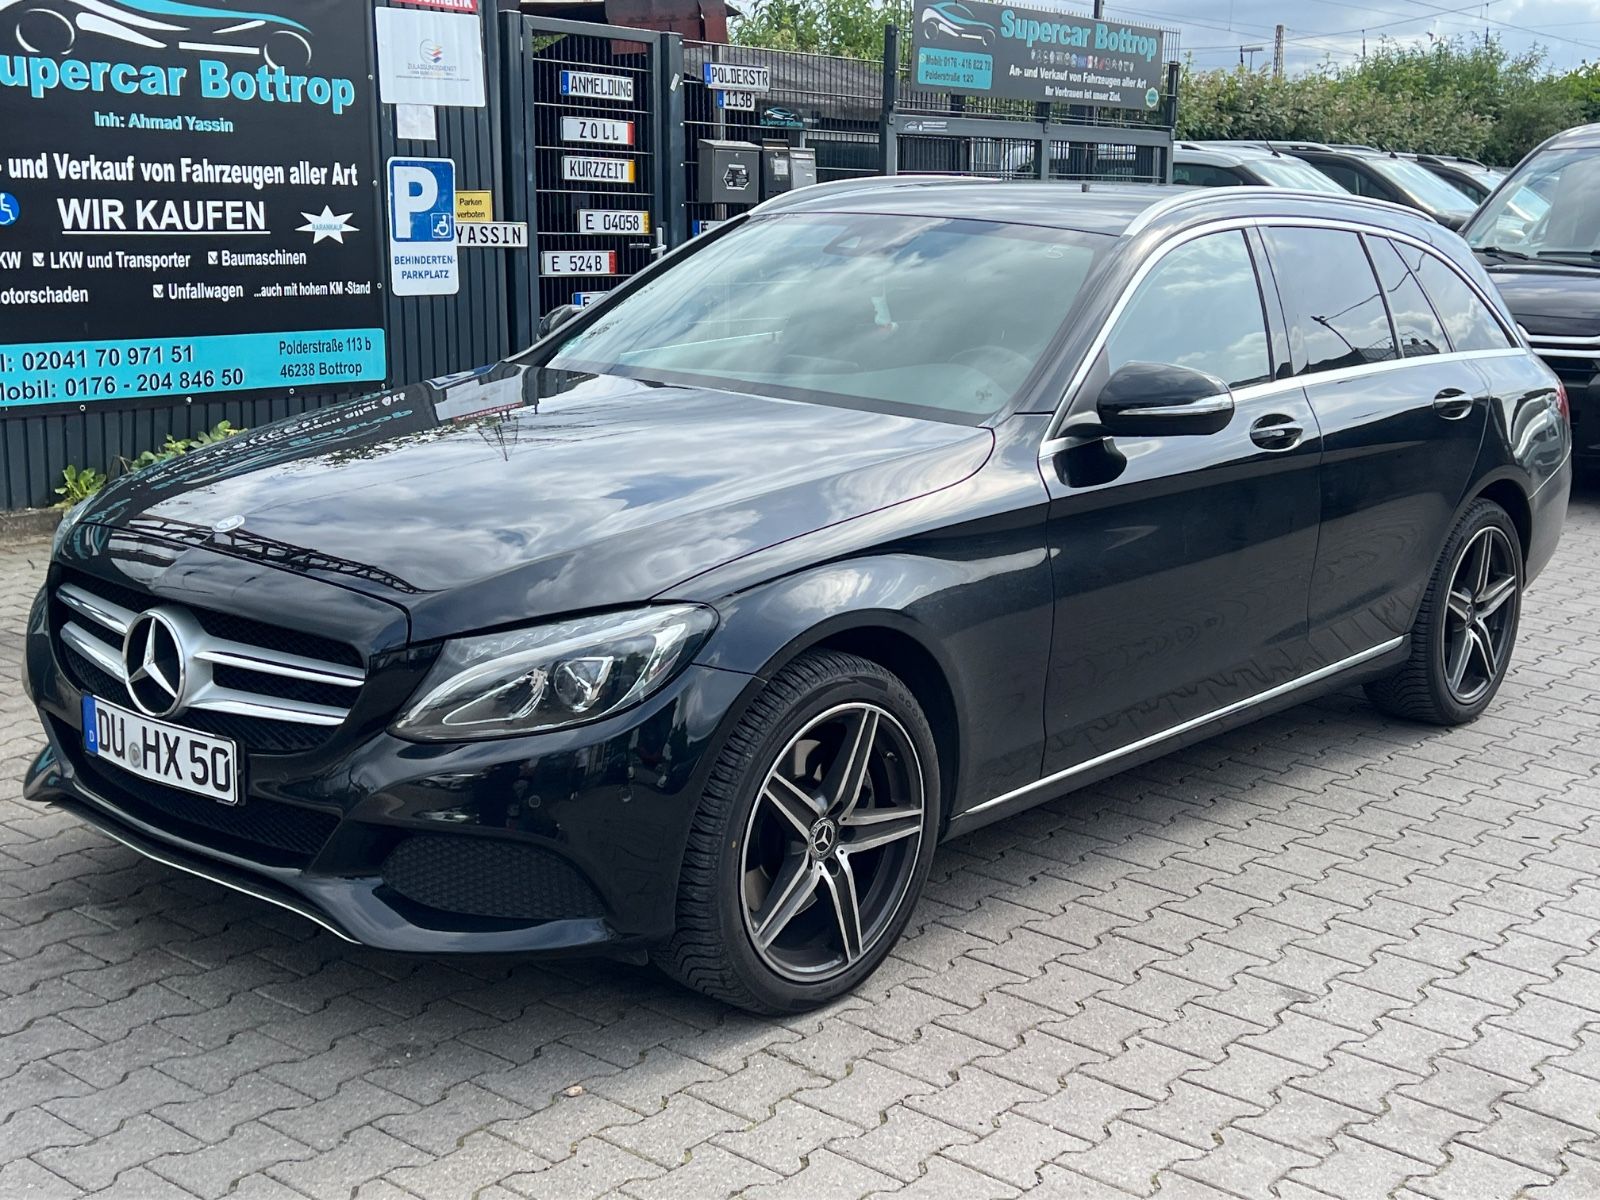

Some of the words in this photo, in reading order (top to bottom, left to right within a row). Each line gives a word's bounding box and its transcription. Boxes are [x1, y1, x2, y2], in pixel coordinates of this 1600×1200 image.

[1000, 9, 1091, 47] Supercar
[1095, 23, 1157, 62] Bottrop
[200, 59, 355, 114] Bottrop
[571, 75, 632, 98] ANMELDUNG
[711, 67, 768, 86] POLDERSTR
[1009, 64, 1022, 76] An-
[1024, 68, 1038, 78] und
[1040, 66, 1068, 81] Verkauf
[1069, 73, 1081, 82] von
[1083, 72, 1121, 88] Fahrzeugen
[1122, 76, 1135, 88] aller
[1137, 78, 1147, 89] Art
[725, 90, 752, 108] 113B
[1055, 86, 1083, 98] Vertrauen
[1084, 89, 1092, 99] ist
[94, 111, 125, 128] Inh:
[129, 113, 182, 131] Ahmad
[186, 115, 233, 133] Yassin
[579, 121, 619, 141] ZOLL
[9, 153, 48, 180] und
[53, 153, 135, 182] Verkauf
[141, 163, 175, 183] von
[181, 158, 284, 190] Fahrzeugen
[290, 161, 326, 185] aller
[332, 162, 358, 186] Art
[569, 160, 625, 180] KURZZEIT
[393, 166, 438, 239] P
[459, 198, 482, 206] Parken
[57, 198, 124, 230] WIR
[136, 200, 266, 230] KAUFEN
[586, 214, 594, 230] E
[603, 214, 639, 231] 04058
[456, 226, 521, 244] YASSIN
[50, 251, 83, 269] LKW
[87, 251, 113, 268] und
[115, 250, 191, 272] Transporter
[221, 250, 307, 267] Baumaschinen
[394, 255, 456, 265] BEHINDERTEN-
[552, 256, 560, 271] E
[401, 270, 449, 279] PARKPLATZ
[0, 286, 89, 304] otorschaden
[168, 283, 243, 302] Unfallwagen
[284, 285, 297, 297] mit
[299, 283, 328, 296] hohem
[330, 283, 343, 295] KM
[279, 338, 344, 356] Polderstraße
[347, 339, 363, 353] 113
[365, 338, 371, 351] b
[22, 349, 87, 371] 02041
[95, 348, 121, 367] 70
[128, 346, 162, 366] 971
[171, 345, 194, 363] 51
[280, 363, 315, 378] 46238
[318, 362, 362, 378] Bottrop
[65, 376, 116, 397] 0176
[137, 371, 172, 392] 204
[179, 369, 215, 390] 846
[221, 367, 243, 387] 50
[97, 708, 125, 760] DU
[142, 726, 182, 780] HX
[190, 740, 231, 792] 50
